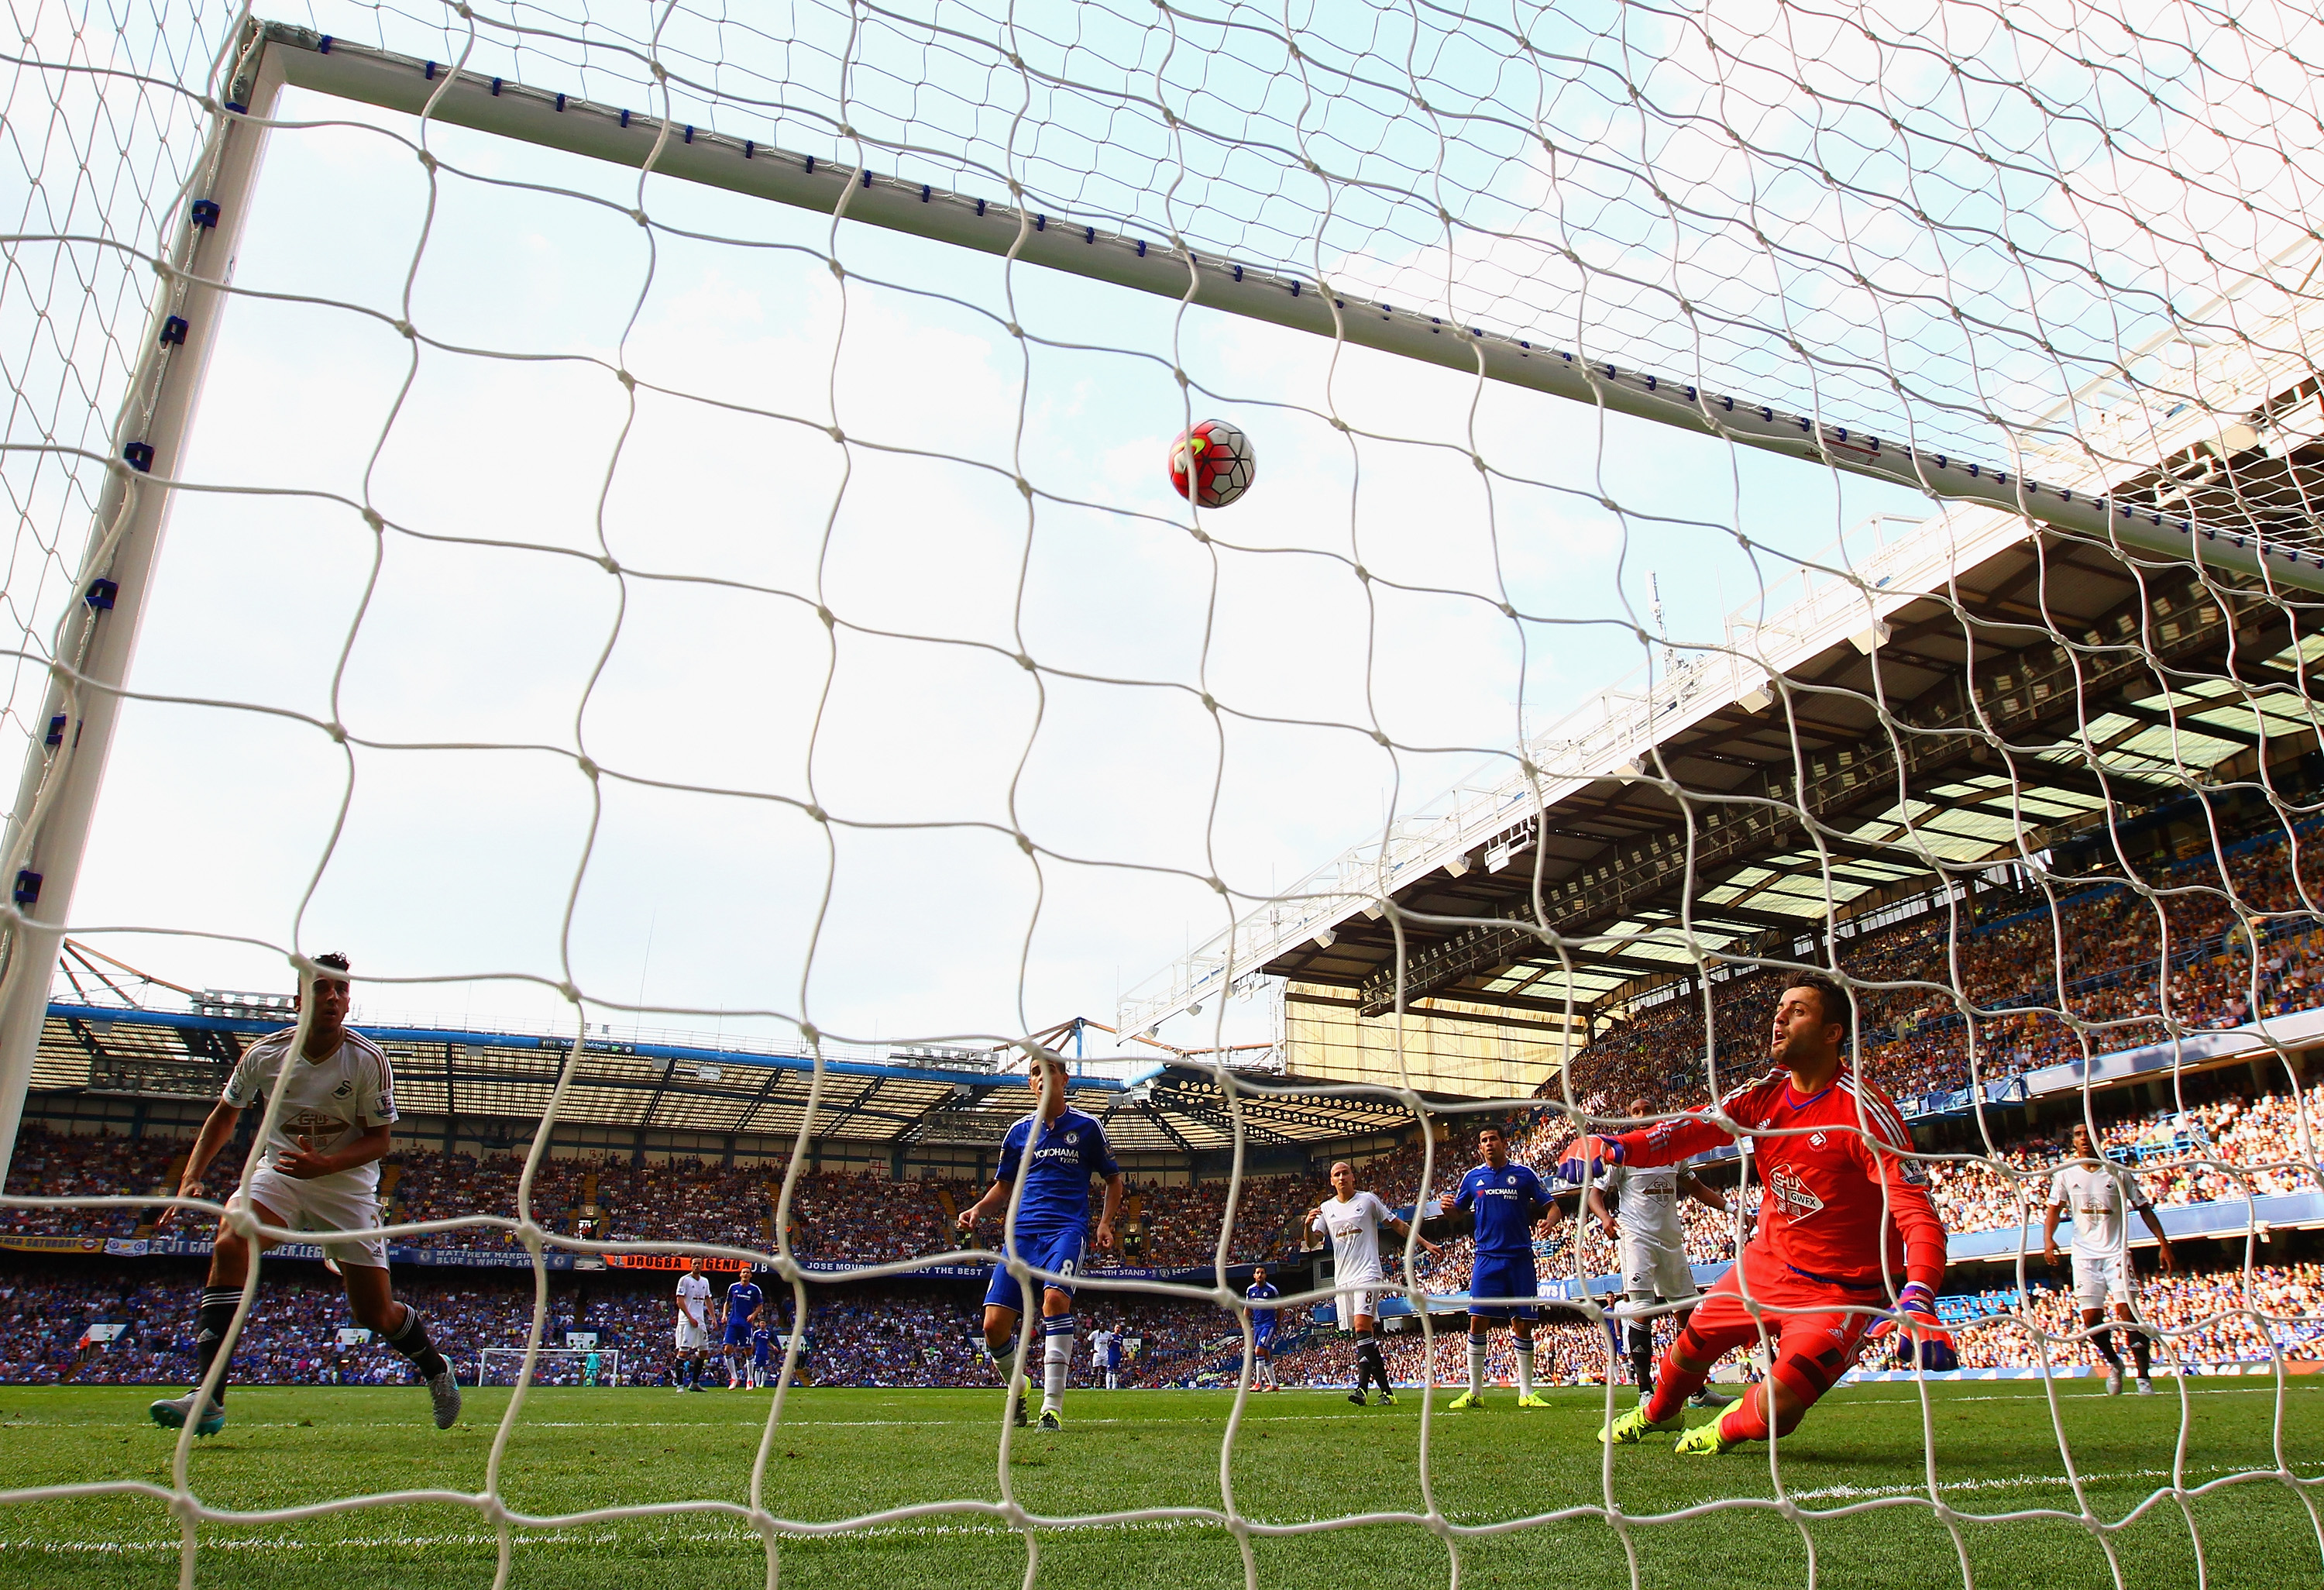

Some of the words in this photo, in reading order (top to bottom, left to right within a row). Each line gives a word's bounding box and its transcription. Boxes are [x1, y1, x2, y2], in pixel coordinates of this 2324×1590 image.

[1033, 1148, 1079, 1159] YOKOHAMA
[1790, 1192, 1817, 1207] GWFX
[168, 1241, 184, 1253] JT
[627, 1256, 681, 1268] DROGBA
[1061, 1259, 1074, 1279] 8
[1537, 1285, 1558, 1297] OYS
[1366, 1291, 1373, 1304] 8
[1260, 1336, 1267, 1344] 4
